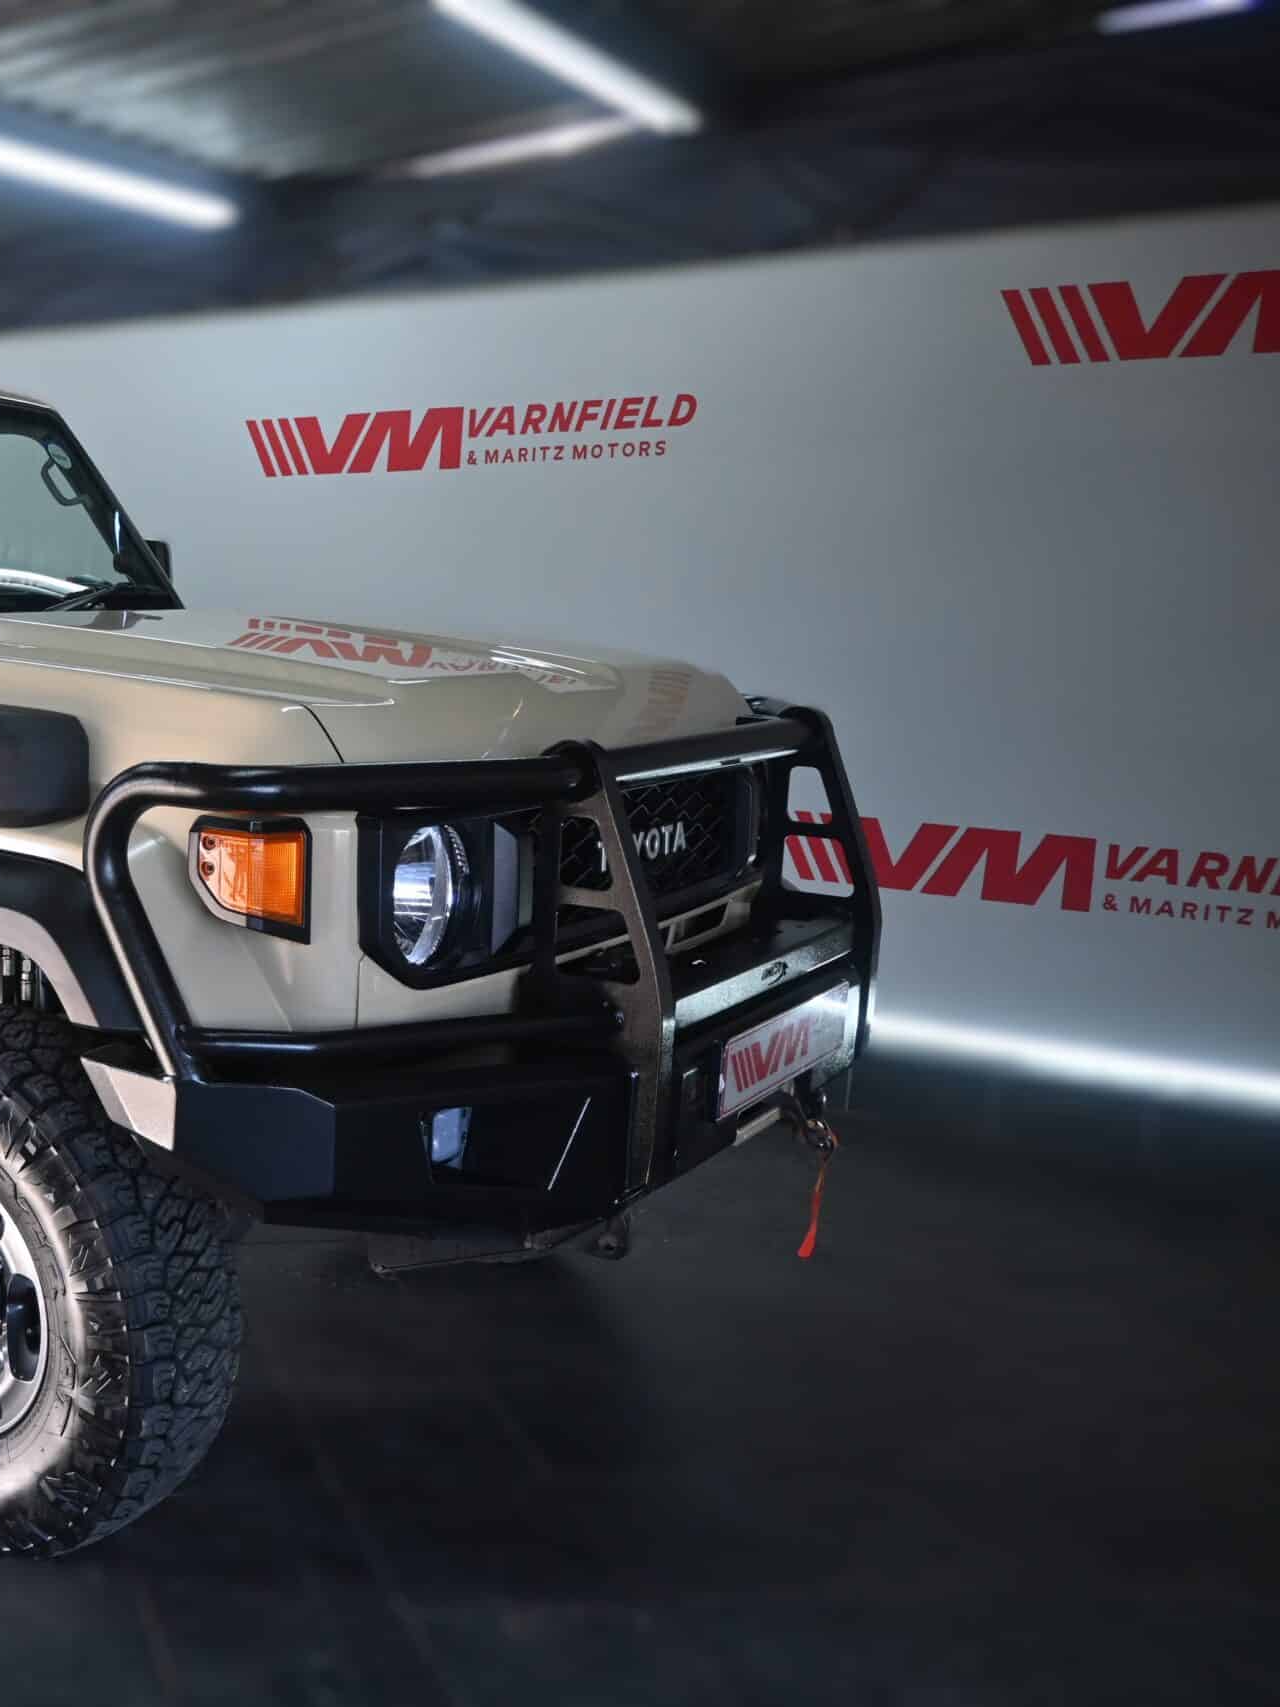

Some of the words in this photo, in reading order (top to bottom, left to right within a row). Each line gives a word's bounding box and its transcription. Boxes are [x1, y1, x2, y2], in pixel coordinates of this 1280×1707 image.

[293, 406, 465, 475] VM
[468, 393, 698, 439] VARNFIELD
[467, 450, 478, 466] &
[484, 445, 566, 465] MARITZ
[572, 440, 667, 461] MOTORS
[597, 821, 687, 873] TYOTA
[858, 816, 1098, 913] VM
[1105, 843, 1280, 896] VARN
[1103, 893, 1119, 912] &
[1129, 895, 1255, 926] MARITZ
